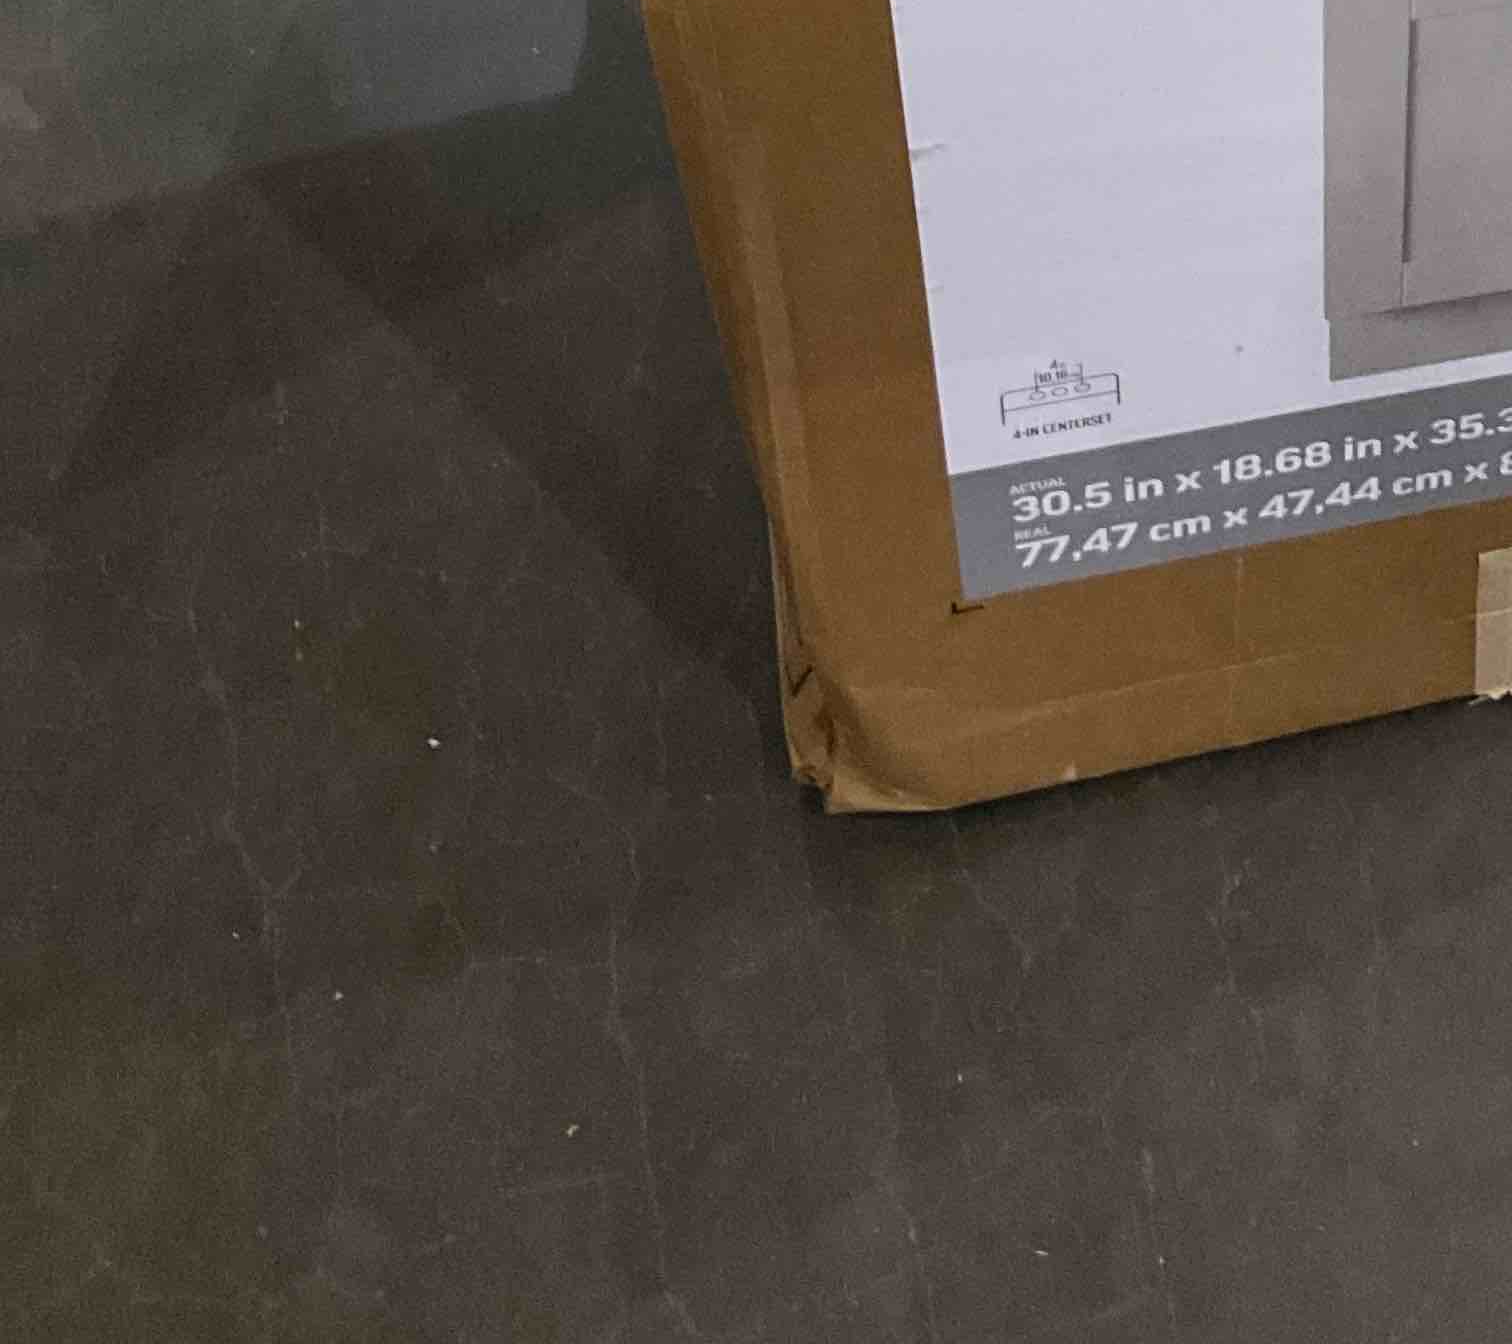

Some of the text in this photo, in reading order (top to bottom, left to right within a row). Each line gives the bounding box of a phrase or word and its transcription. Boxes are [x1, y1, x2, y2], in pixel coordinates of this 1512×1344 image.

[1043, 412, 1111, 434] CENTERSET
[1009, 476, 1066, 495] ACTUAL
[1012, 481, 1112, 522] 30.5
[1124, 475, 1164, 503] in
[1176, 470, 1200, 494] x
[1213, 441, 1332, 485] 18.68
[1344, 435, 1381, 462] in
[1393, 429, 1419, 455] x
[1149, 513, 1211, 542] cm
[1222, 507, 1248, 529] x
[1258, 476, 1382, 521] 47,44
[1391, 467, 1452, 496] cm
[1463, 460, 1489, 485] x
